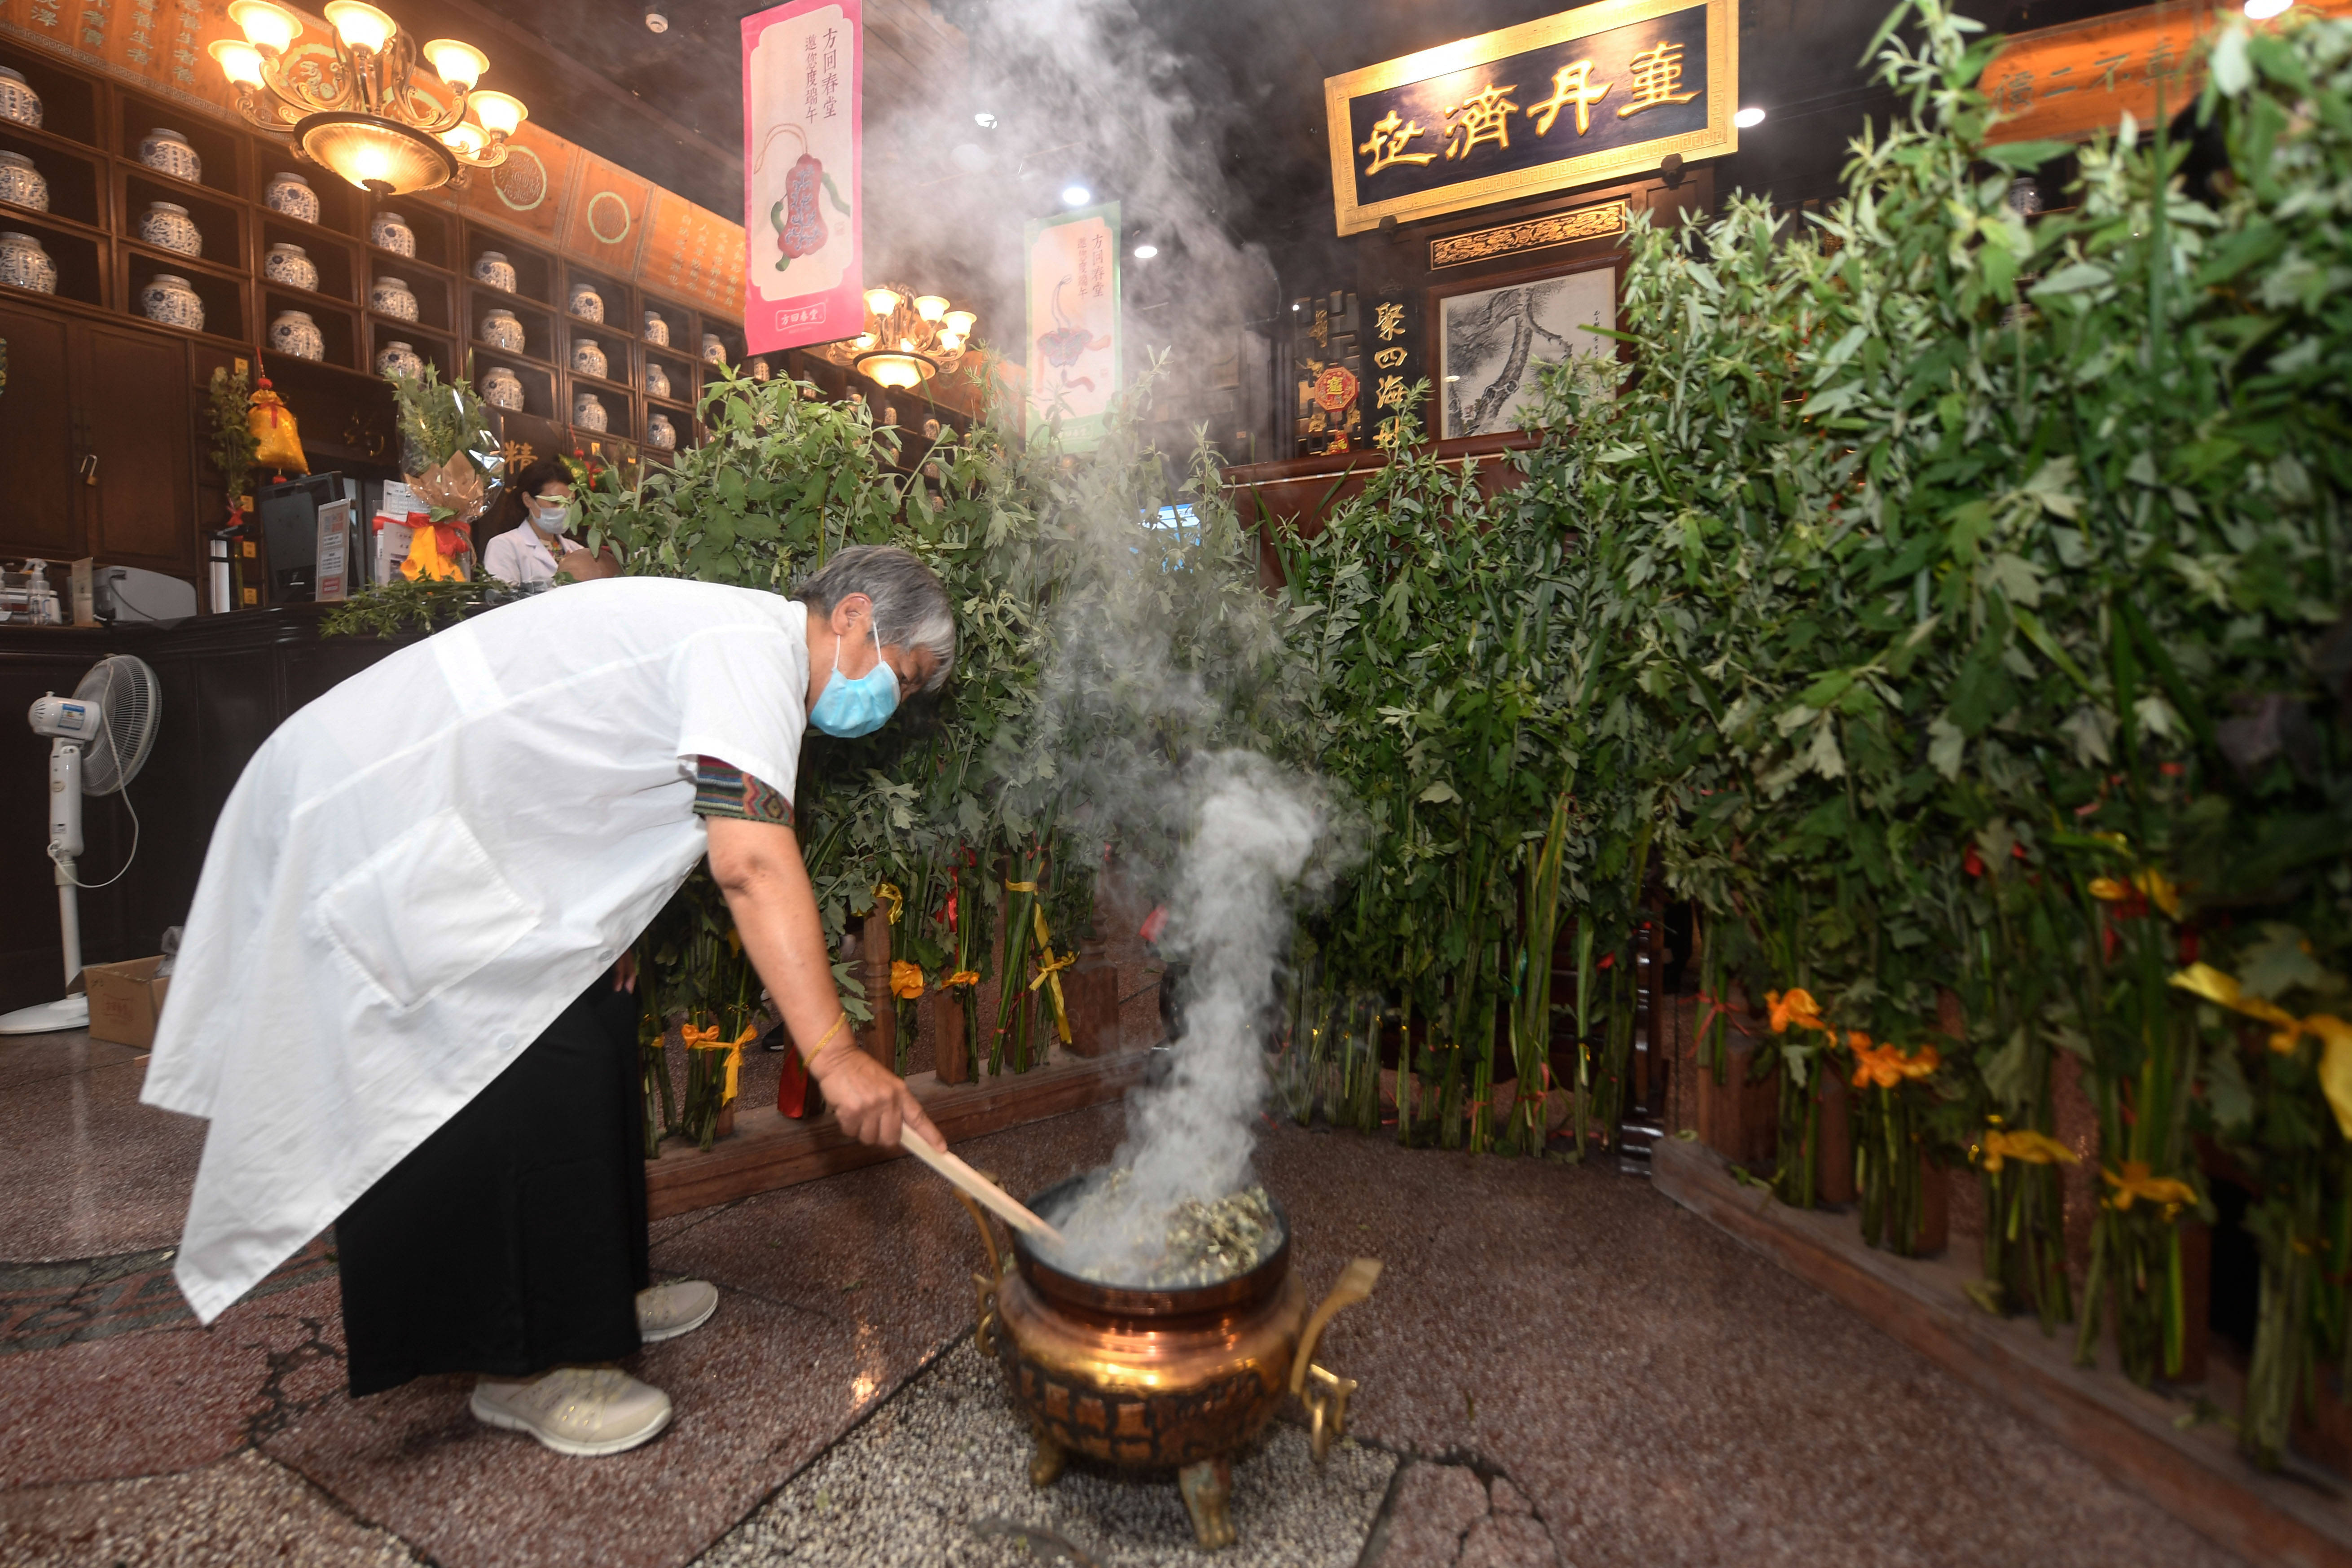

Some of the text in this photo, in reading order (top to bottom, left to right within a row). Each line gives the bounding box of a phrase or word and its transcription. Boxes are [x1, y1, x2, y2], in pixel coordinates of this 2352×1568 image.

[805, 34, 818, 123] 邀您度端午
[822, 28, 838, 119] 方回春堂
[1092, 234, 1105, 297] 方回春堂
[781, 308, 818, 325] 方回春堂
